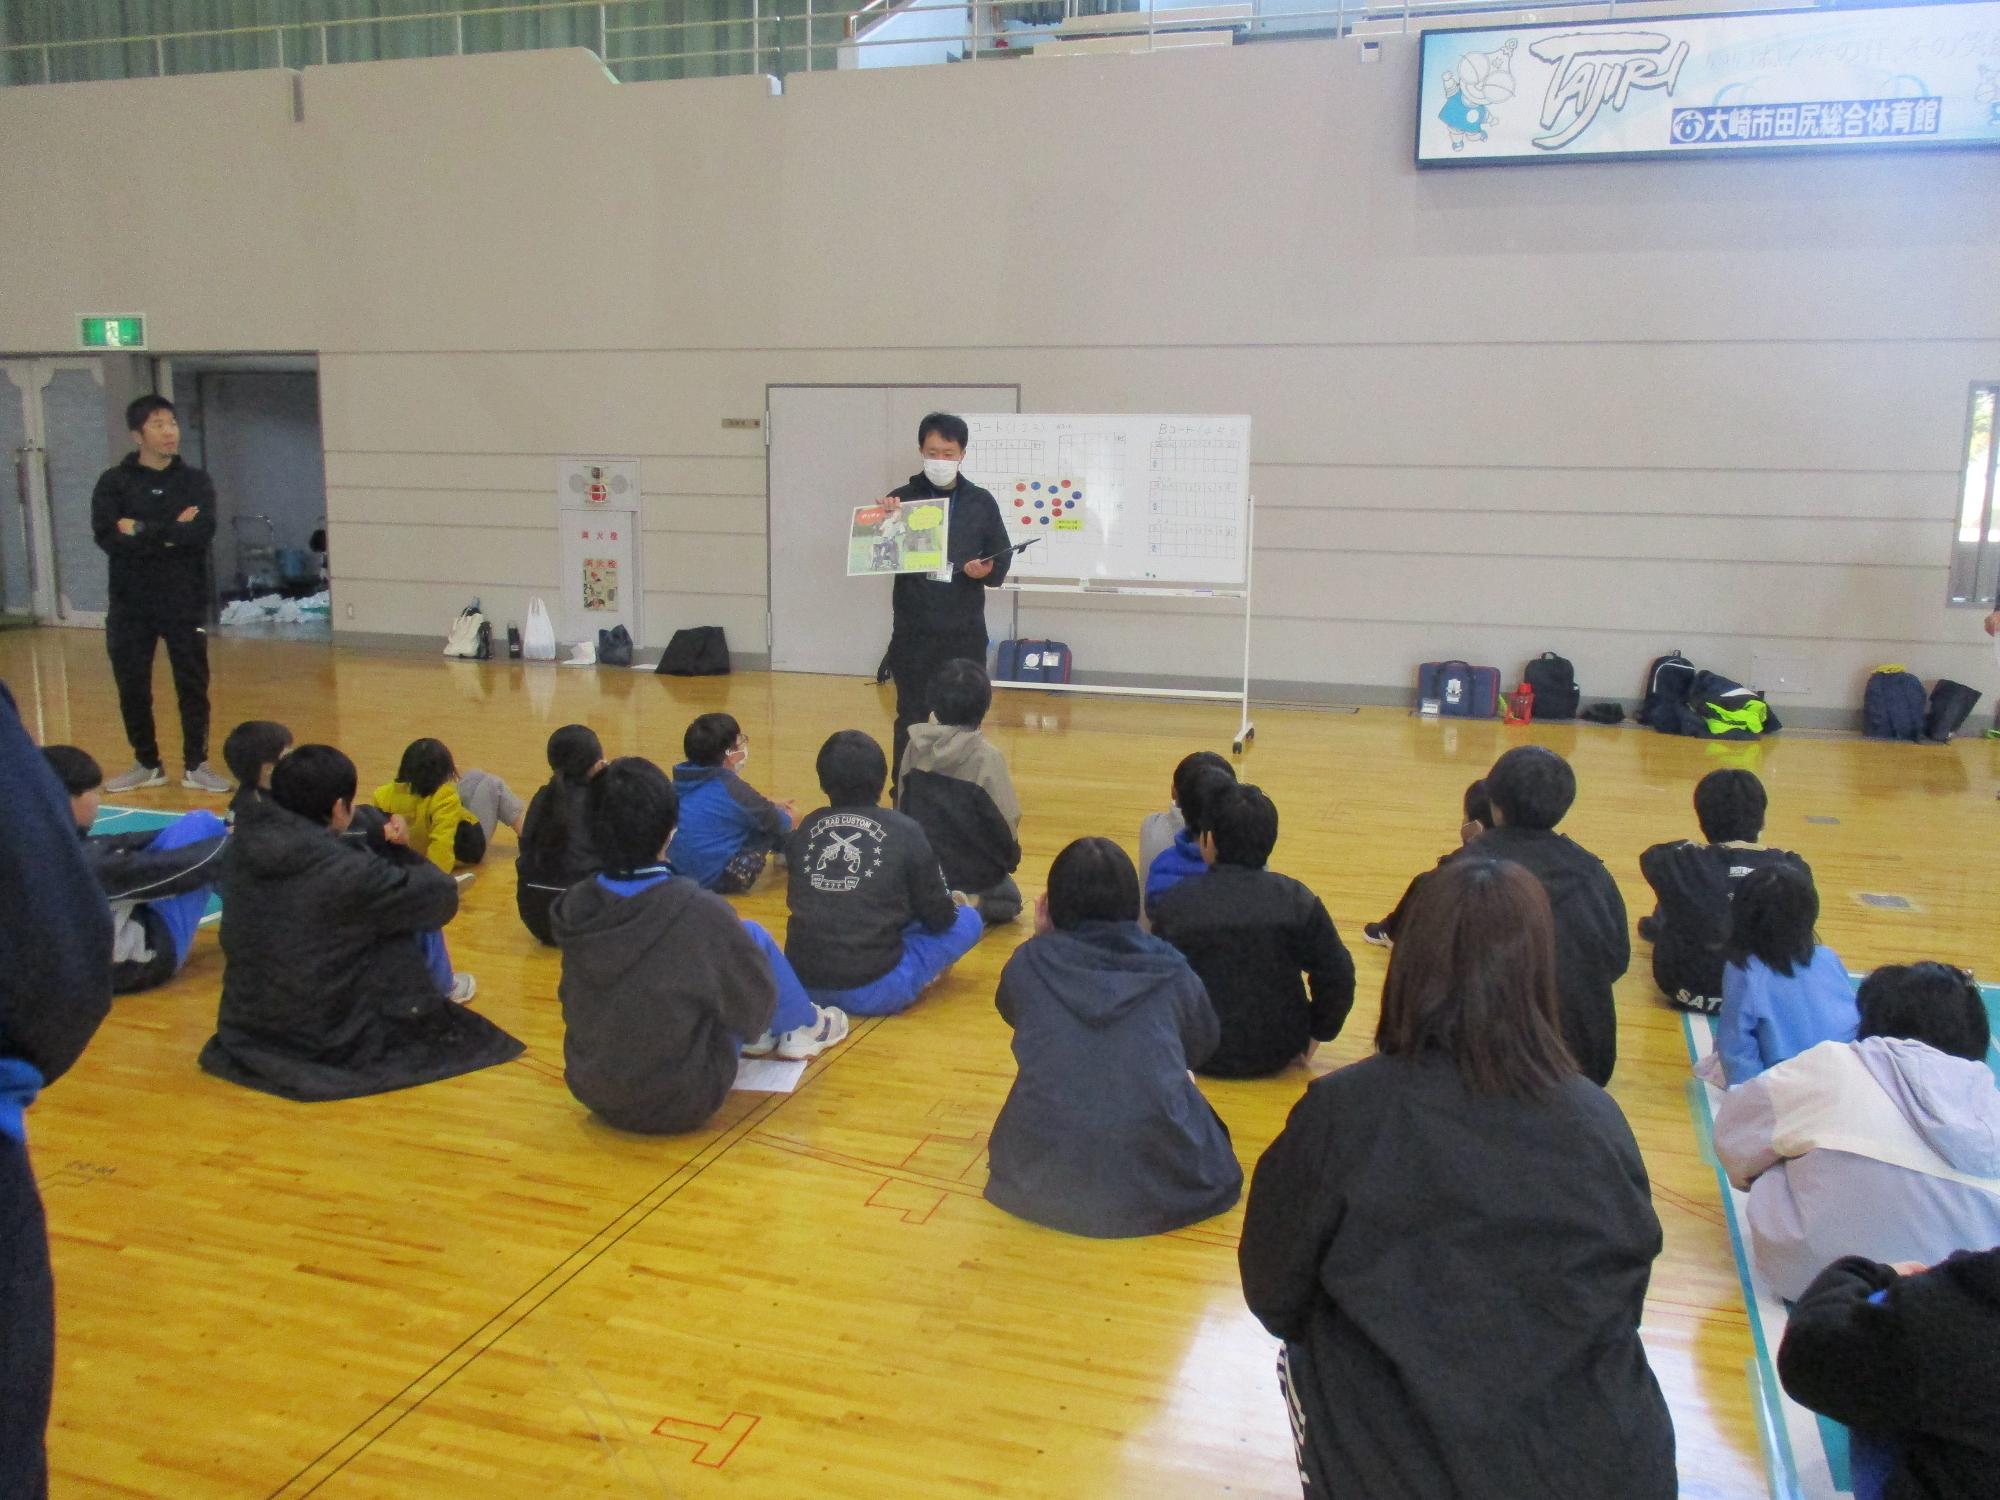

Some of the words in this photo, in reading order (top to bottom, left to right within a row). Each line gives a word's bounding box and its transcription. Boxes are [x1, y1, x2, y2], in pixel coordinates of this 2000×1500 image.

[1705, 98, 1939, 140] 大崎市田尻総合体育館
[841, 815, 872, 829] CUSTOM
